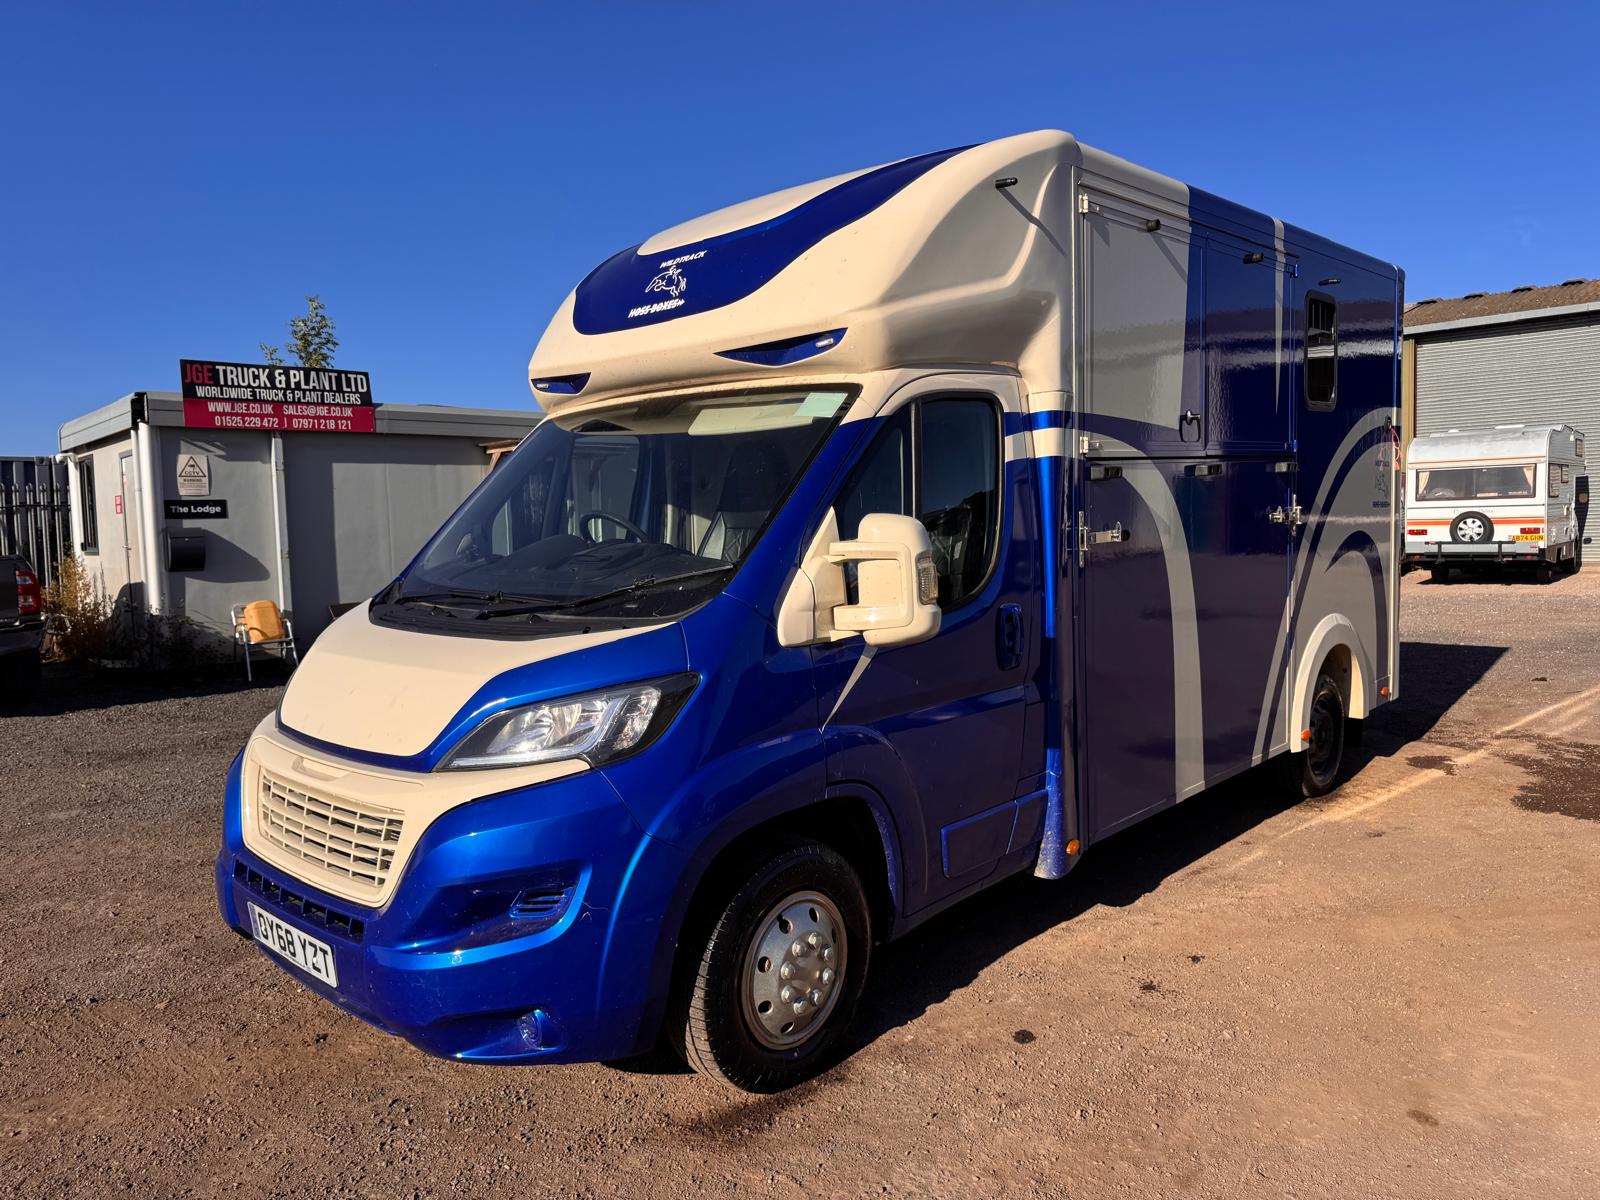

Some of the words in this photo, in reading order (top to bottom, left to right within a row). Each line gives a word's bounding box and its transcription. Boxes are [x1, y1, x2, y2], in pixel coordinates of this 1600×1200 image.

[659, 250, 708, 268] WILDTRACK
[185, 363, 214, 384] JGE
[216, 365, 271, 388] TRUCK
[274, 369, 286, 388] &
[289, 369, 338, 391] PLANT
[341, 373, 368, 393] LTD
[195, 385, 254, 400] WORLDWIDE
[254, 388, 285, 402] TRUCK
[286, 390, 293, 402] &
[294, 390, 322, 403] PLANT
[324, 392, 361, 405] DEALERS
[207, 401, 274, 414] WWW.JGE.CO.UK
[283, 404, 353, 417] SALES@JGE.CO.UK
[214, 415, 242, 427] 01525
[244, 416, 261, 428] 229
[262, 417, 279, 428] 472
[292, 418, 318, 429] 07971
[320, 419, 335, 430] 218
[337, 420, 352, 430] 121
[169, 505, 189, 513] The
[190, 505, 222, 514] Lodge
[297, 935, 330, 979] YZT
